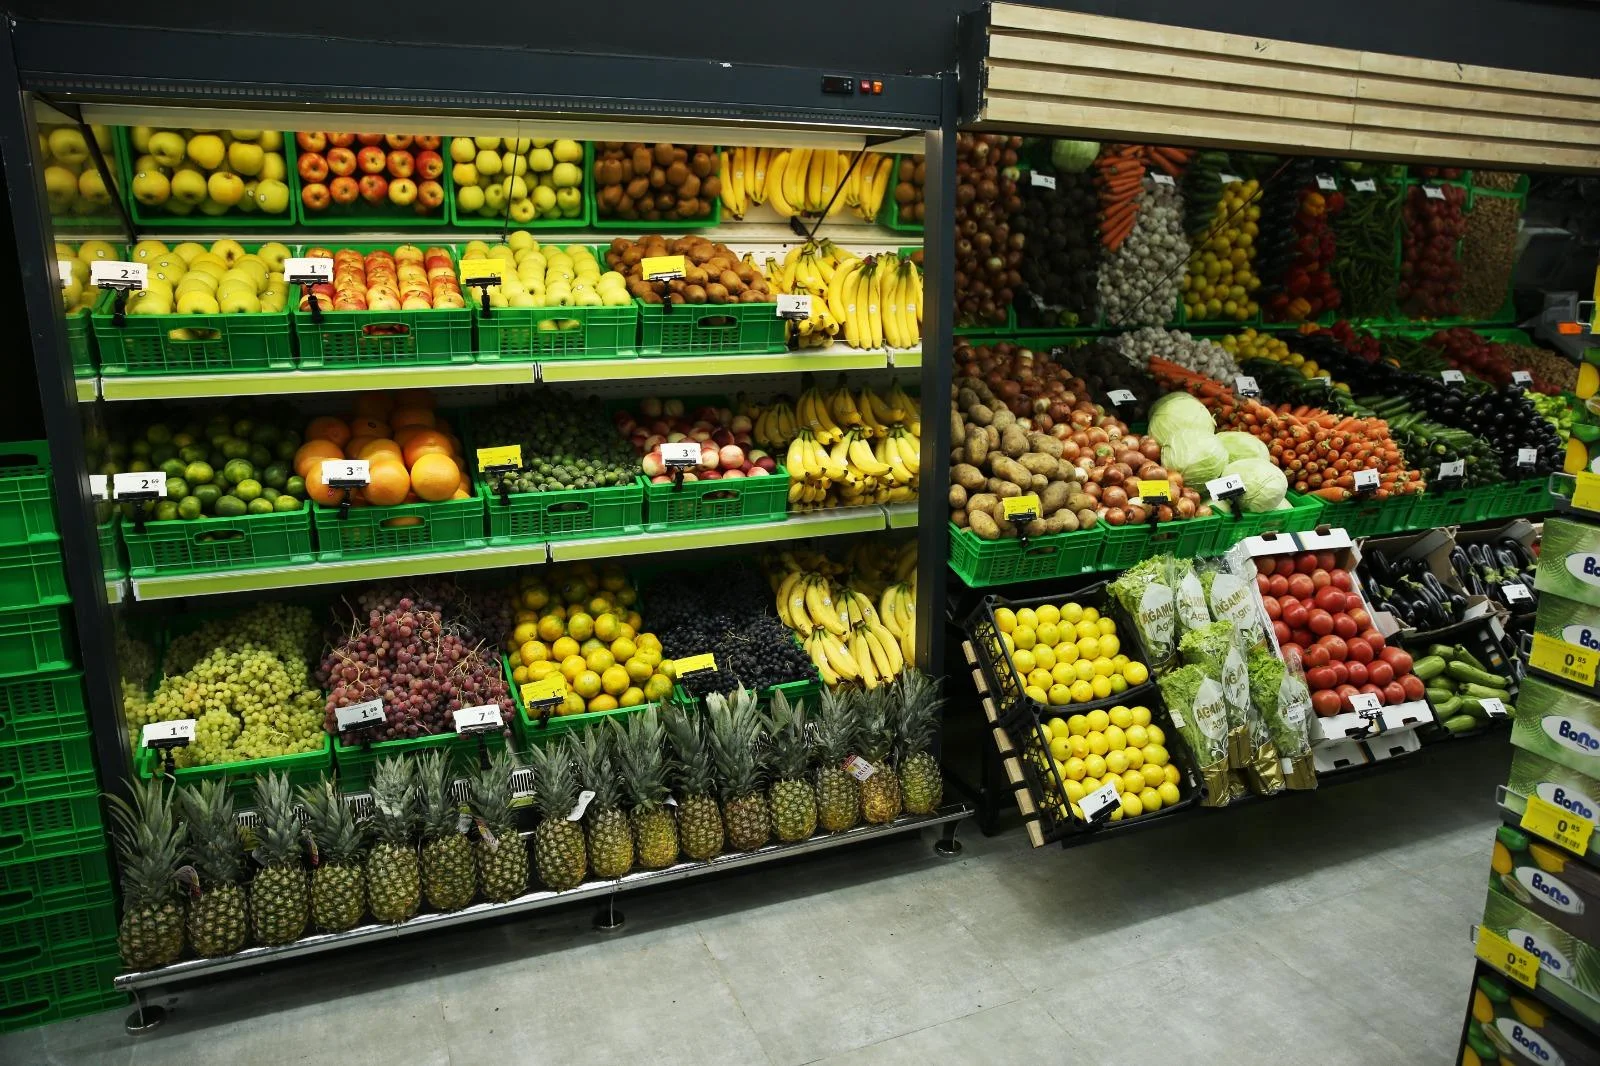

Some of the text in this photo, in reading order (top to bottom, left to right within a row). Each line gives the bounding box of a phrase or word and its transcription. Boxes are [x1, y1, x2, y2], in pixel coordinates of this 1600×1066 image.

[120, 269, 129, 279] 2
[310, 265, 317, 274] 1
[795, 301, 801, 310] 2
[682, 449, 689, 457] 3
[346, 466, 354, 476] 3
[141, 479, 149, 489] 2
[1226, 481, 1233, 489] 0
[1580, 629, 1600, 650] Bo
[1565, 653, 1587, 666] 0 85
[361, 709, 369, 719] 1
[478, 712, 486, 721] 7
[170, 727, 178, 736] 1
[1100, 794, 1109, 804] 2
[1557, 820, 1581, 833] 0 85
[1507, 952, 1516, 965] 0
